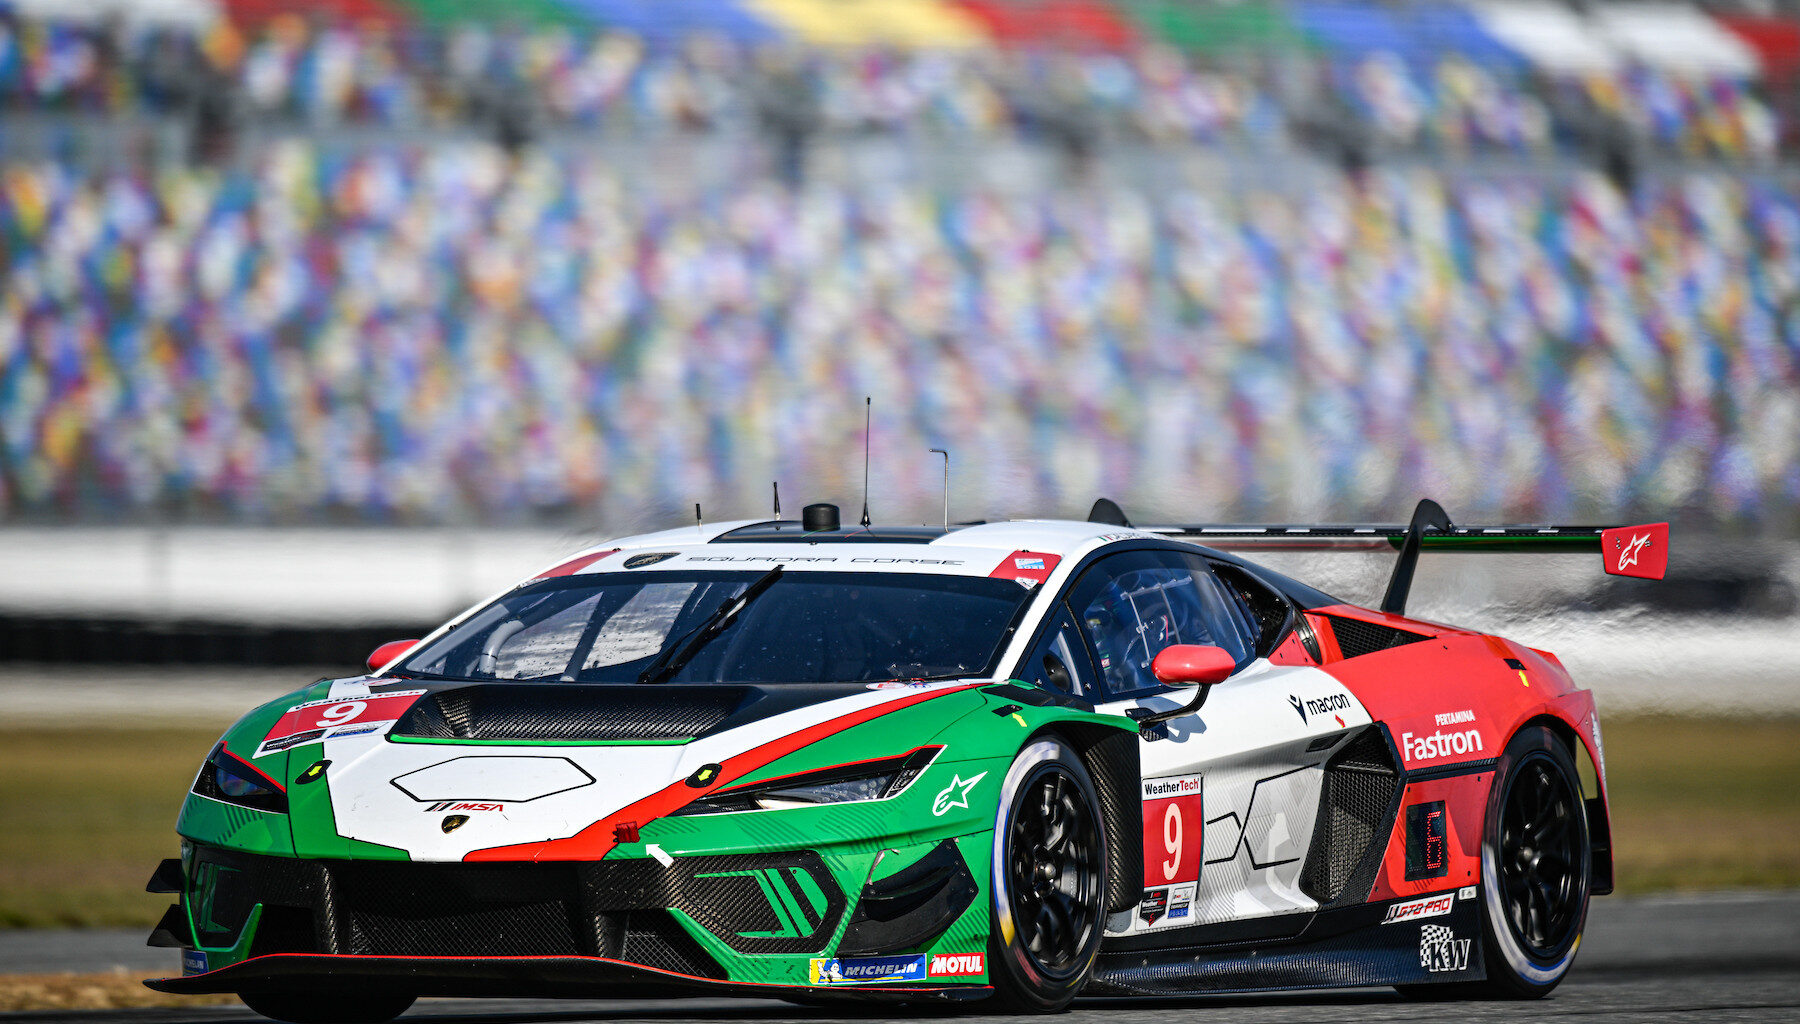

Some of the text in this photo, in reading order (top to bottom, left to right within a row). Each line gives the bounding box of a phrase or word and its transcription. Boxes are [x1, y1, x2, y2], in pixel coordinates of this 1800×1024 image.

[851, 558, 966, 566] CORSE
[295, 690, 420, 710] WeatherTech
[1306, 693, 1351, 716] macron
[315, 701, 368, 728] 9
[1434, 709, 1476, 727] PERTAMINA
[1402, 729, 1483, 762] Fastron
[1144, 778, 1199, 796] WeatherTech
[449, 803, 504, 812] IMSA
[1163, 802, 1183, 881] 9
[1426, 811, 1442, 870] 6
[1396, 897, 1451, 918] GTD PRO
[930, 954, 983, 974] MOTUL
[1429, 939, 1471, 973] KW
[845, 963, 918, 977] MICHELIN
